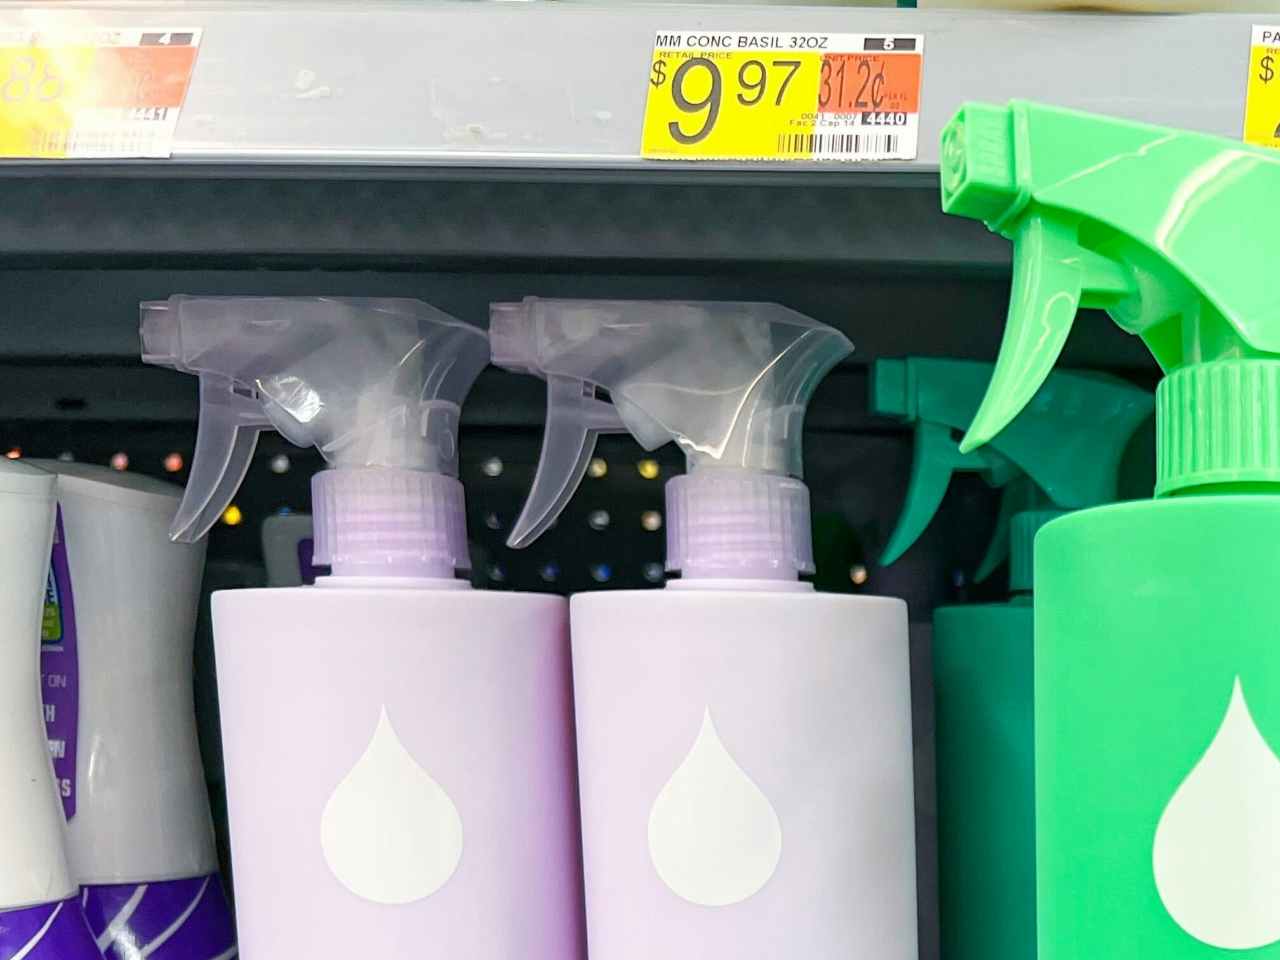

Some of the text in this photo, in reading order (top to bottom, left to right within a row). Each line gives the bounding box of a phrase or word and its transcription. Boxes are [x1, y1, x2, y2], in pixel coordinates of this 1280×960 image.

[656, 34, 829, 50] MM CONC BASIL 32OZ
[659, 51, 733, 60] RETAIL PRICE
[865, 112, 907, 126] 4440
